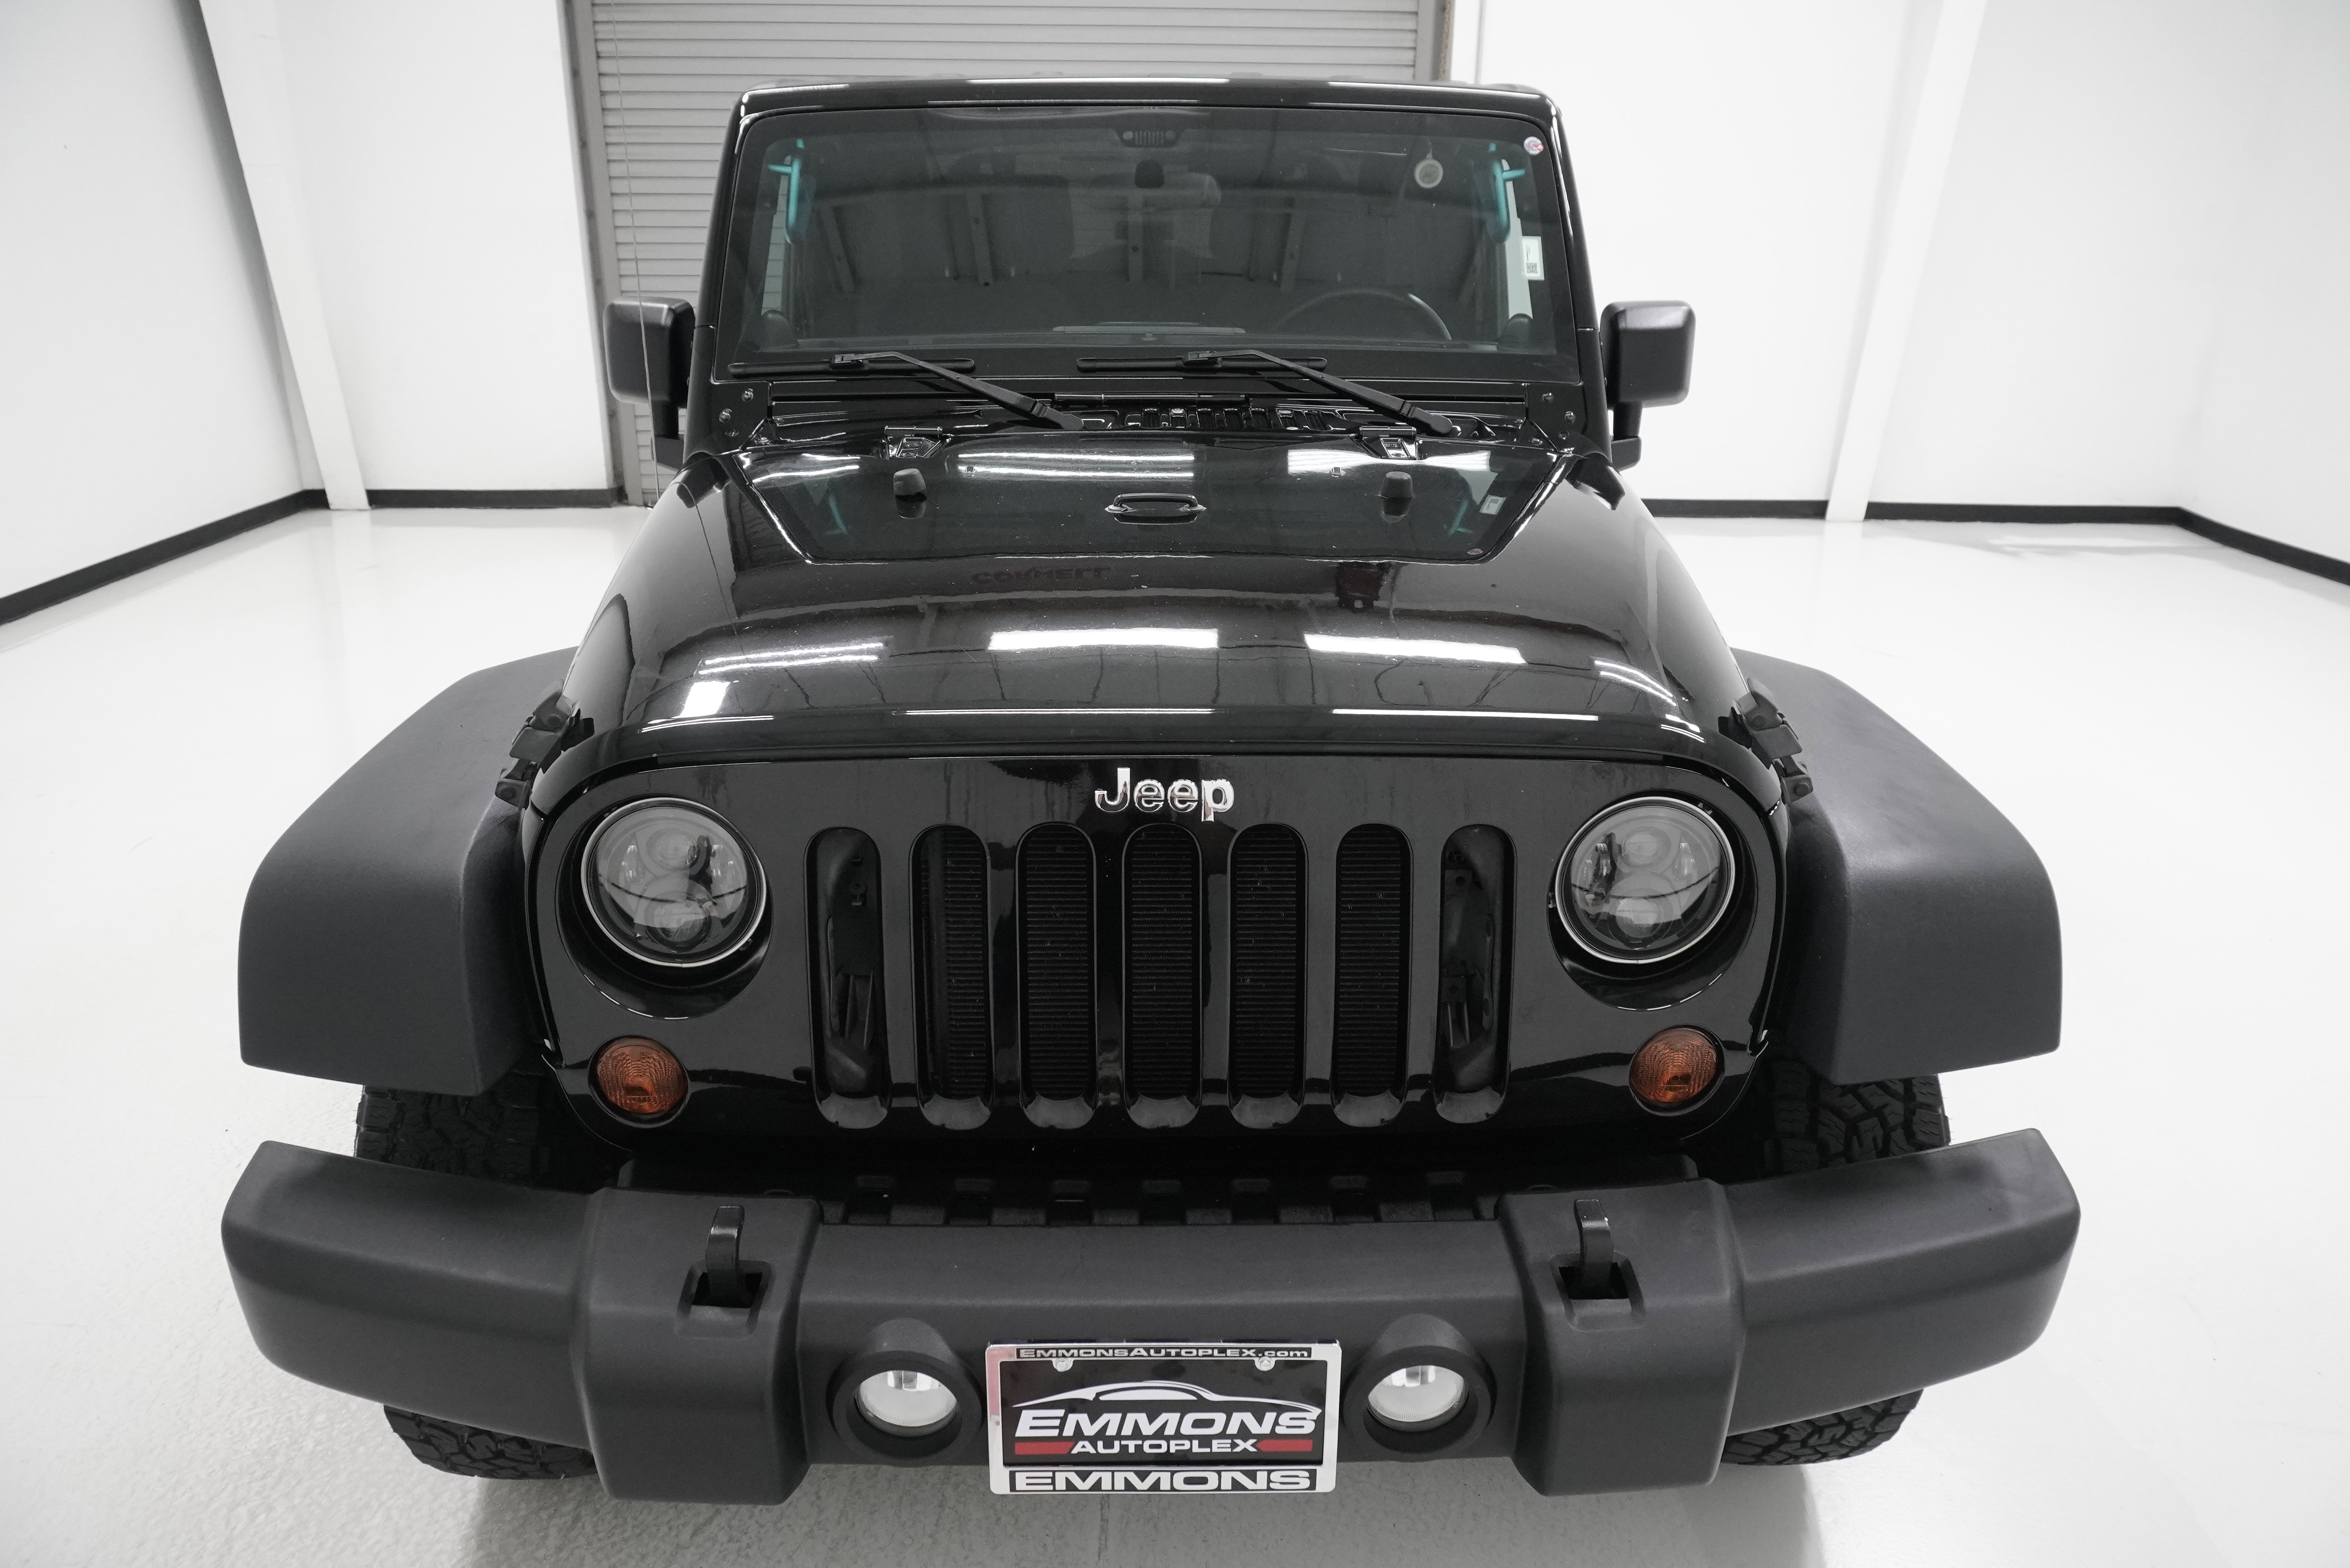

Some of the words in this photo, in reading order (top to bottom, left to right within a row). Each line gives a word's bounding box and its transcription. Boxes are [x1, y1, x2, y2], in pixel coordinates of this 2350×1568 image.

[1095, 767, 1235, 822] Jeep
[1014, 1409, 1319, 1437] EMMONS
[1071, 1439, 1259, 1454] AUTOPLEX
[1015, 1470, 1311, 1491] EMMONS
